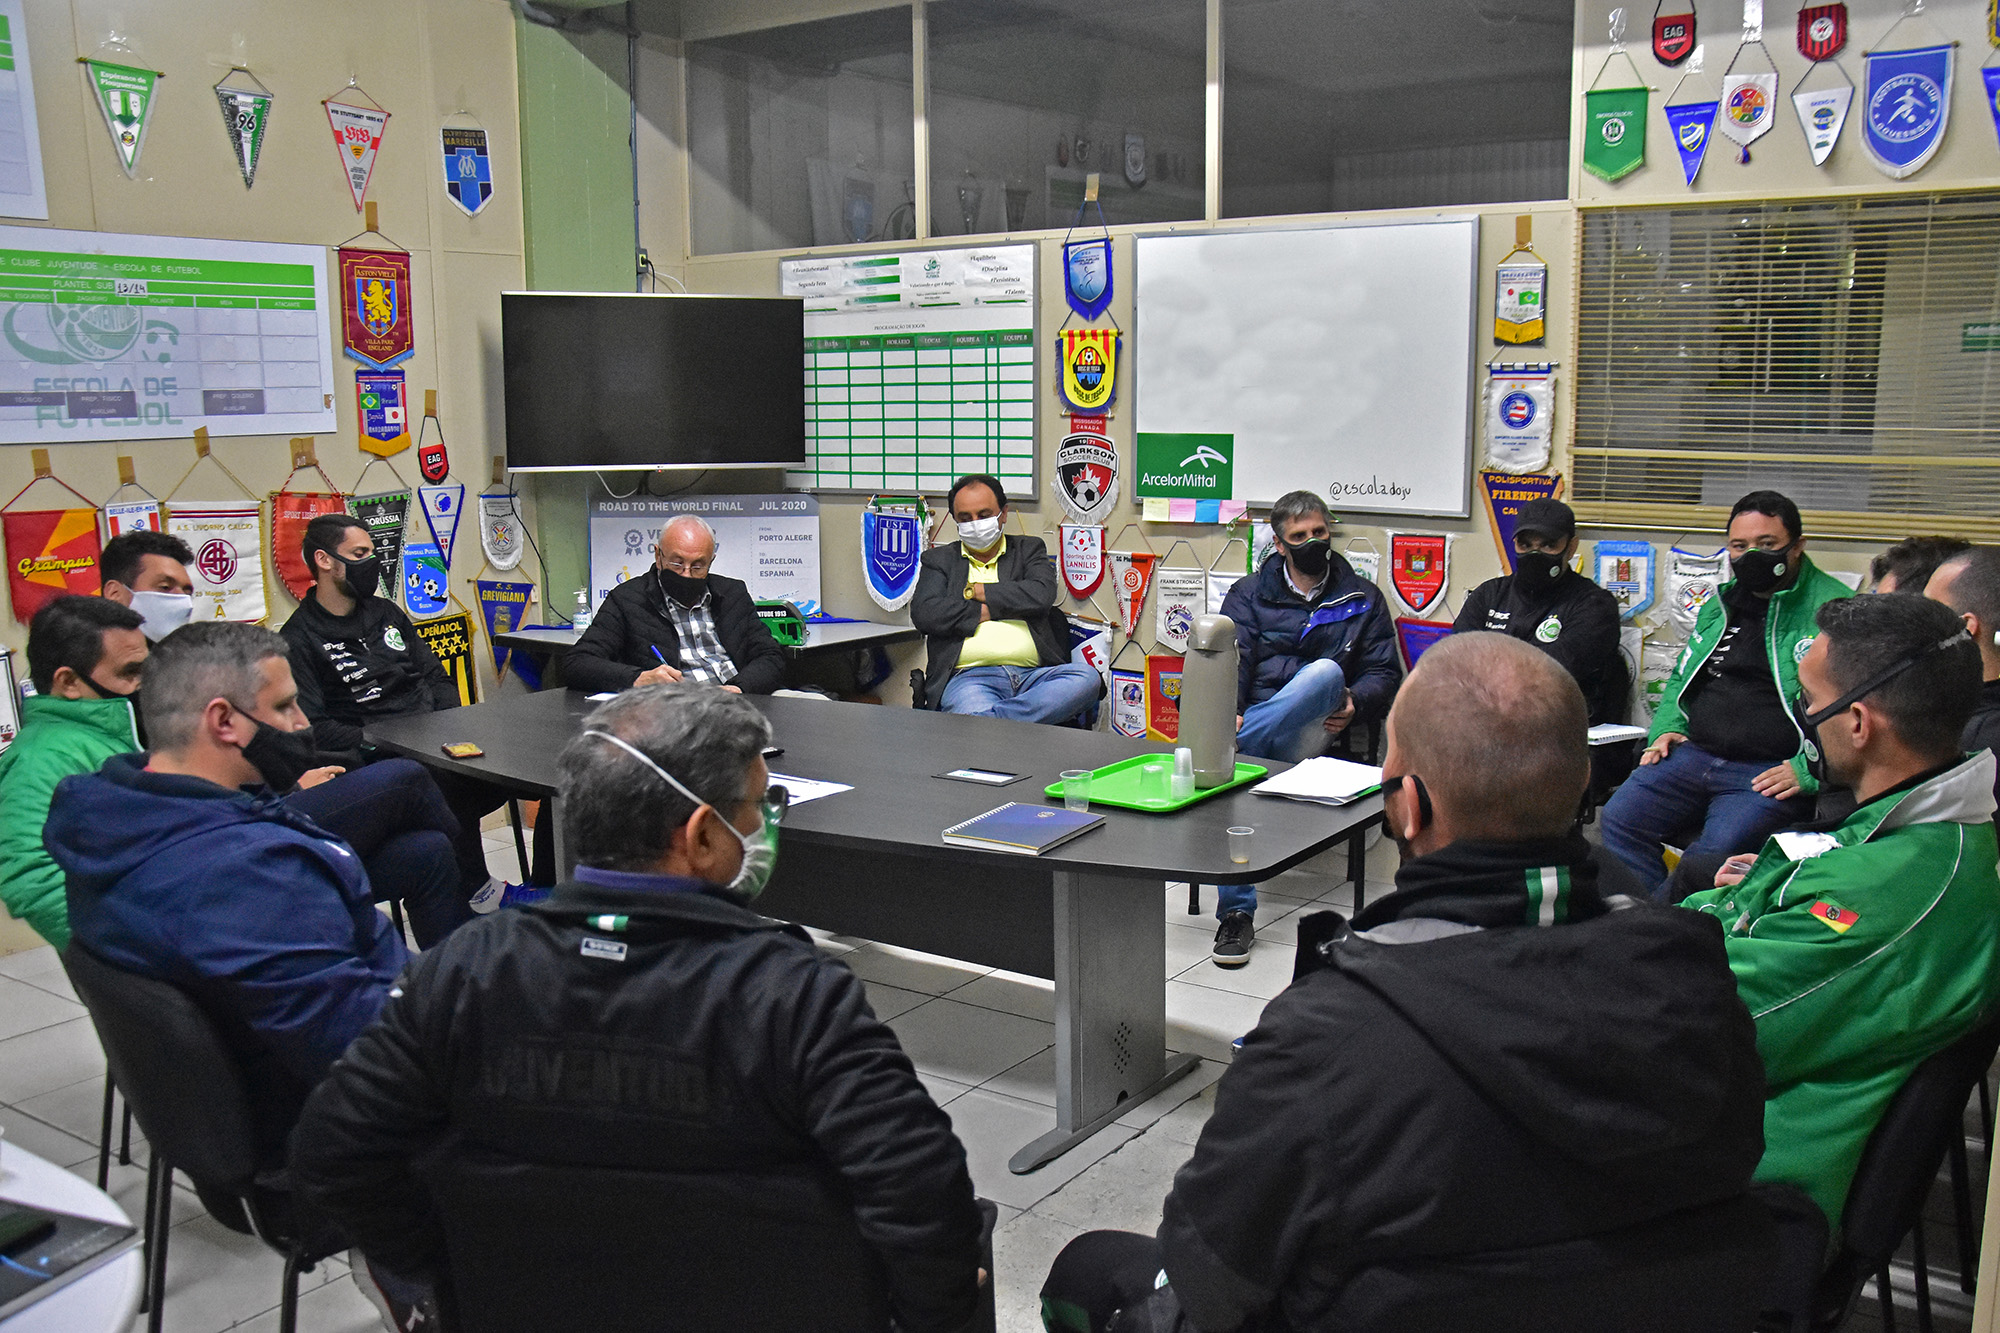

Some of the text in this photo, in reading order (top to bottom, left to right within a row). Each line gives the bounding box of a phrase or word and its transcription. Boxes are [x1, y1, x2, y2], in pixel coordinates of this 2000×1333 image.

[1874, 77, 1939, 108] FOOTBALL CLUB
[238, 113, 257, 131] 96
[444, 138, 486, 147] MARSEILLE
[11, 258, 41, 268] CLUBE
[47, 260, 98, 270] JUVENTUDE
[113, 263, 147, 272] ESCOLA
[151, 265, 162, 273] DE
[167, 265, 202, 275] FUTEBOL
[356, 269, 395, 278] ASTON VILLA
[54, 280, 114, 290] PLANTEL SUB
[144, 377, 178, 396] DE
[1060, 448, 1115, 461] CLARKSON
[1063, 455, 1111, 466] SOCCER CLUB
[1141, 473, 1216, 488] ArcelorMittal
[1488, 475, 1553, 486] POLISPORTIVA
[600, 500, 807, 512] ROAD TO THE WORLD FINAL JUL 2020
[365, 514, 400, 526] ORUSSIA
[17, 555, 95, 577] Grampus
[1066, 561, 1097, 569] LANNILIS
[482, 590, 526, 603] GREVIGIANA
[214, 604, 227, 618] A
[1165, 604, 1187, 615] MAGNA
[483, 1045, 733, 1113] JUVENTUD
